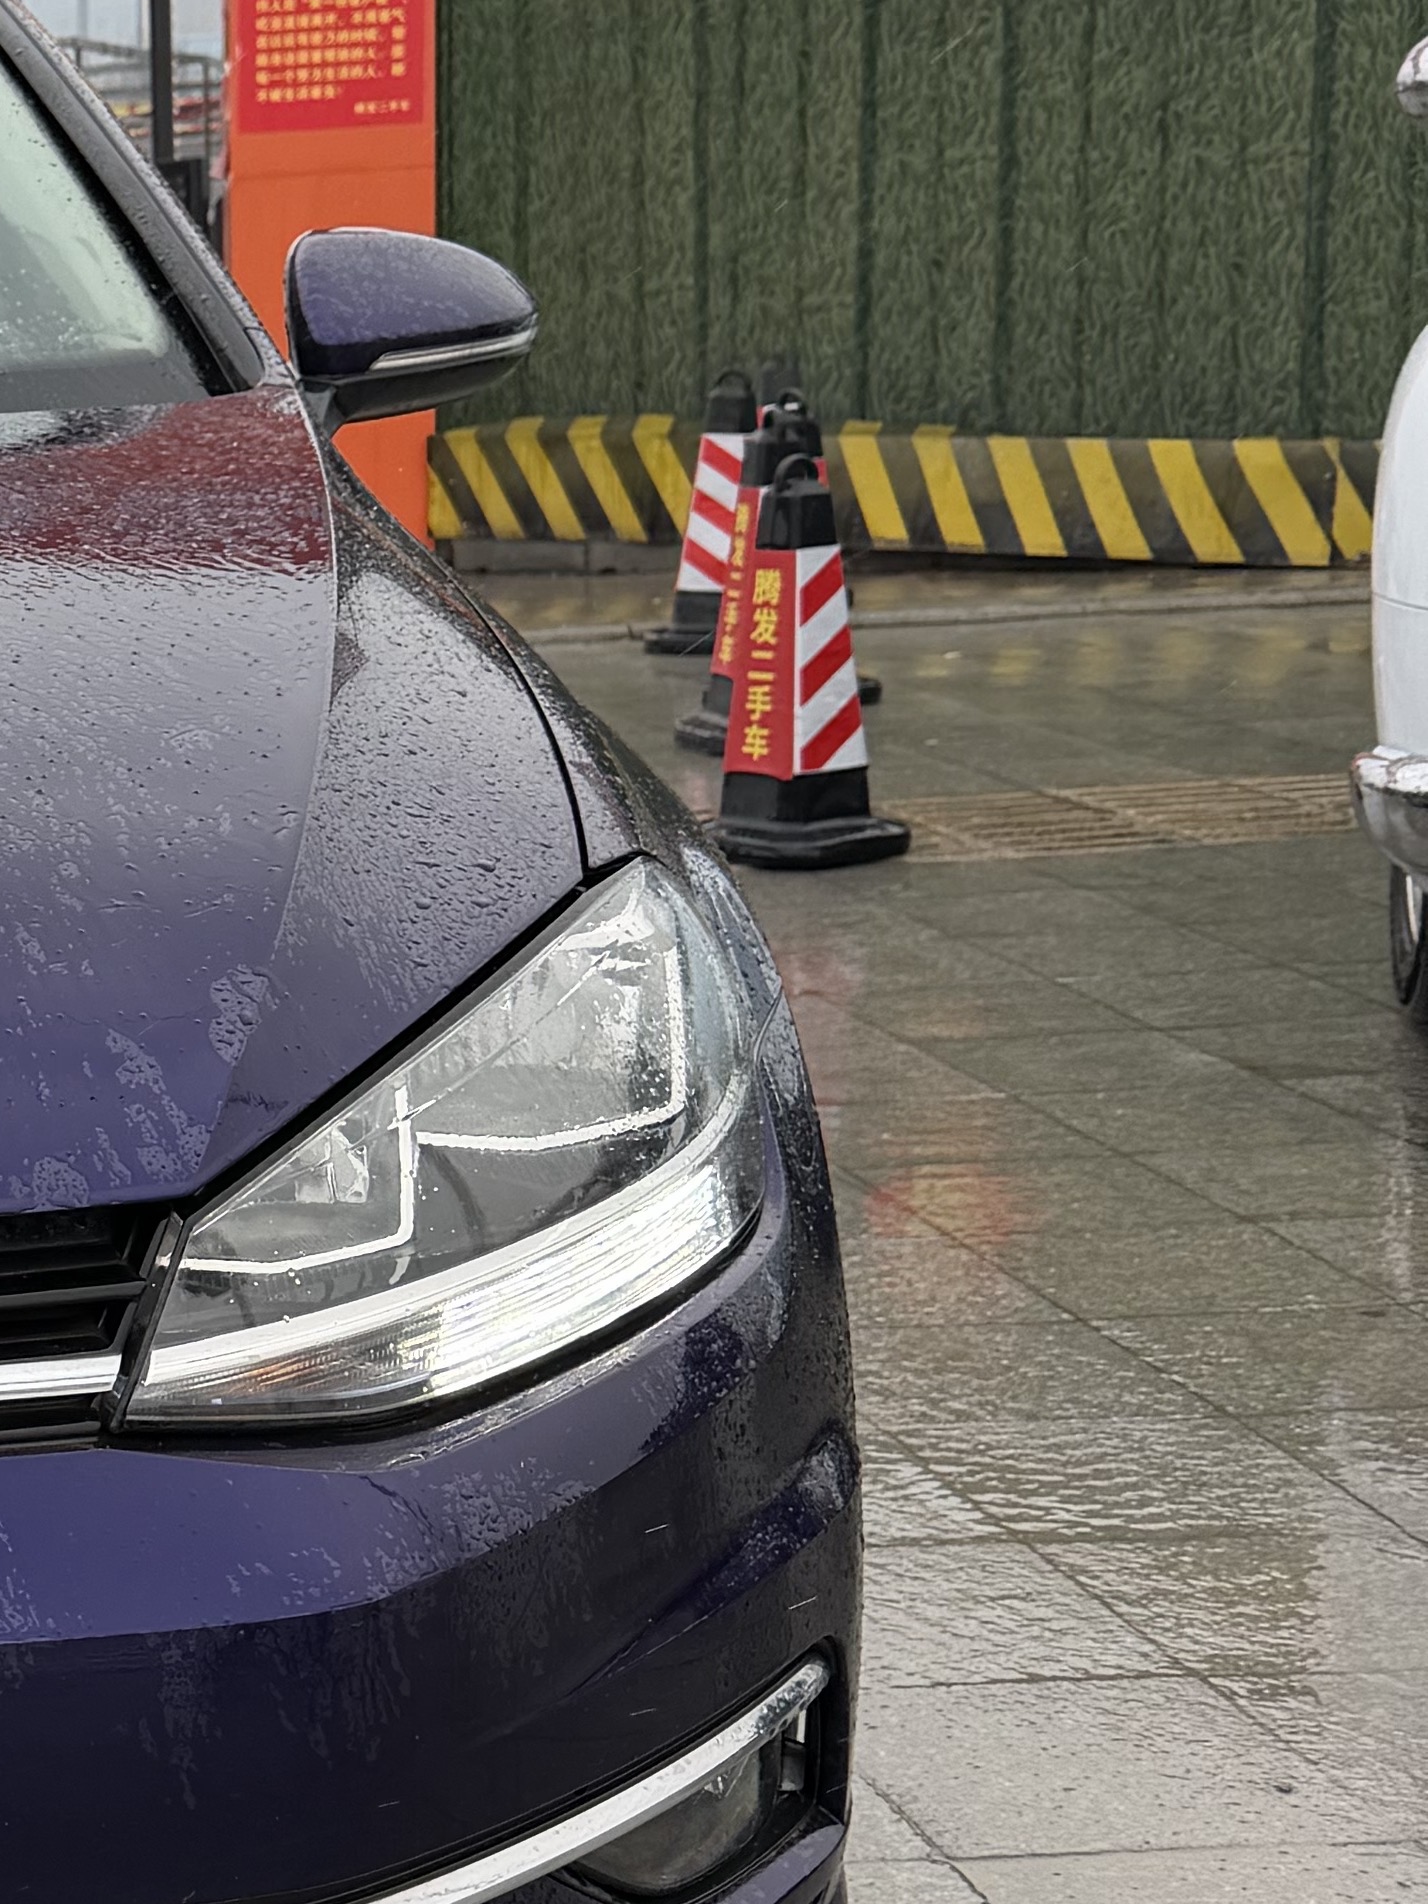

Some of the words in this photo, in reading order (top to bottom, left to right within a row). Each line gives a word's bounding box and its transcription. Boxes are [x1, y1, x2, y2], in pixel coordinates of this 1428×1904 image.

[741, 568, 783, 762] 腾发二手车
